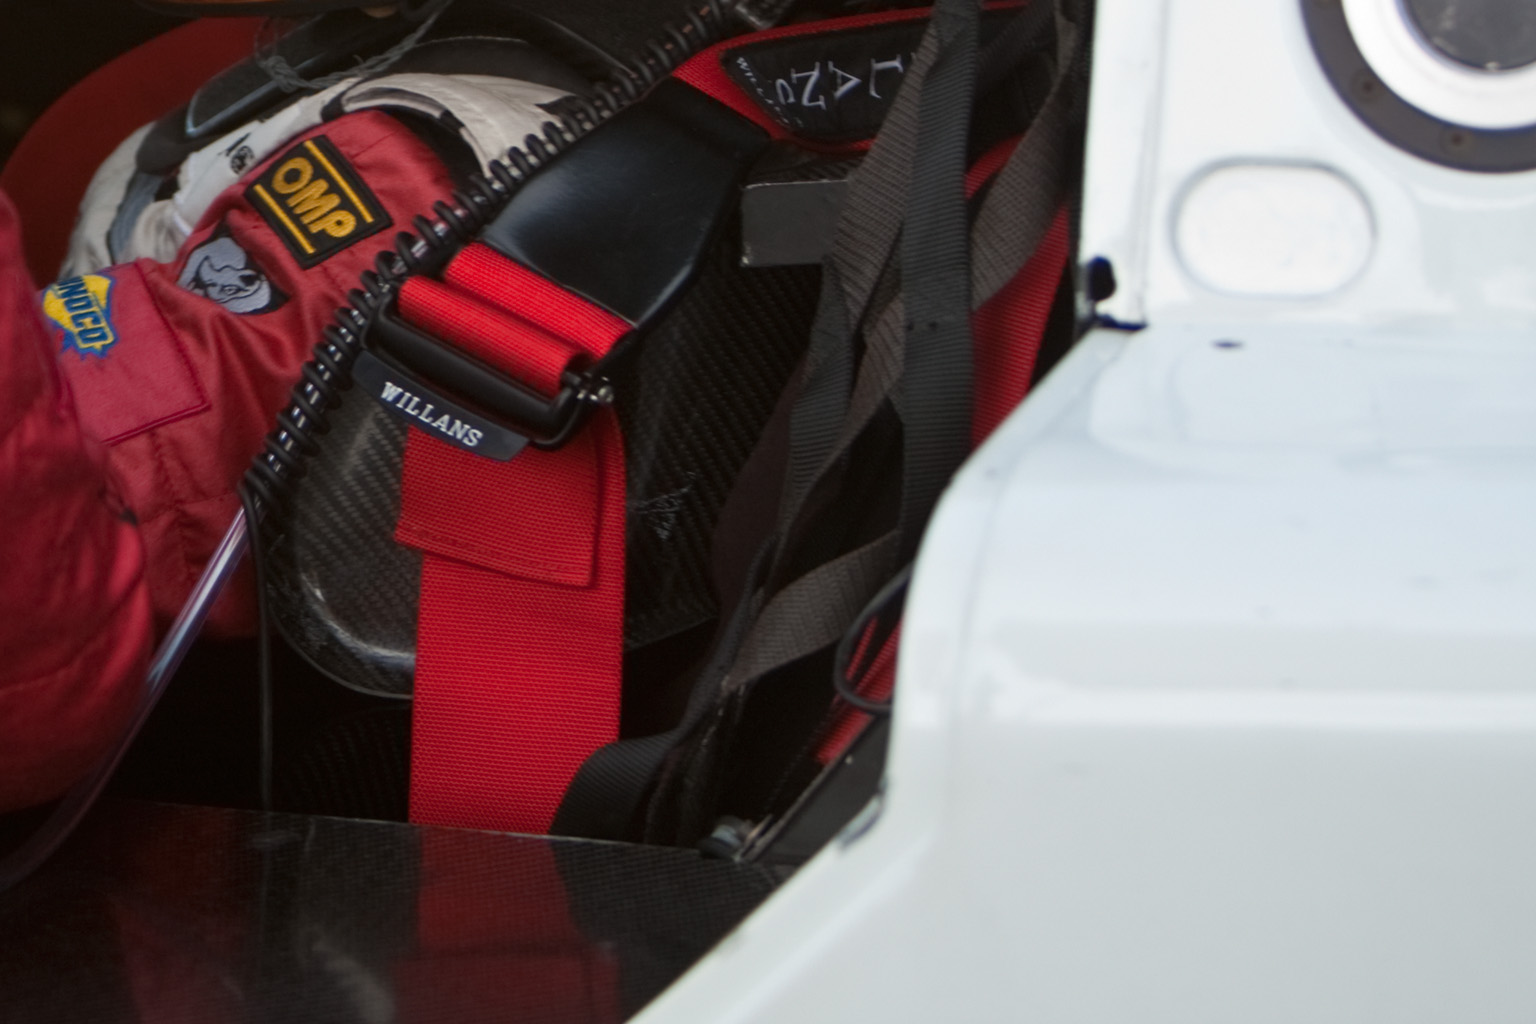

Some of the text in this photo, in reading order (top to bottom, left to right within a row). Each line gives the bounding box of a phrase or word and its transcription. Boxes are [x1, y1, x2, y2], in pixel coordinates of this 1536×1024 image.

[271, 156, 357, 239] OMP
[56, 275, 110, 347] NOCO
[380, 381, 484, 447] WILLANS
